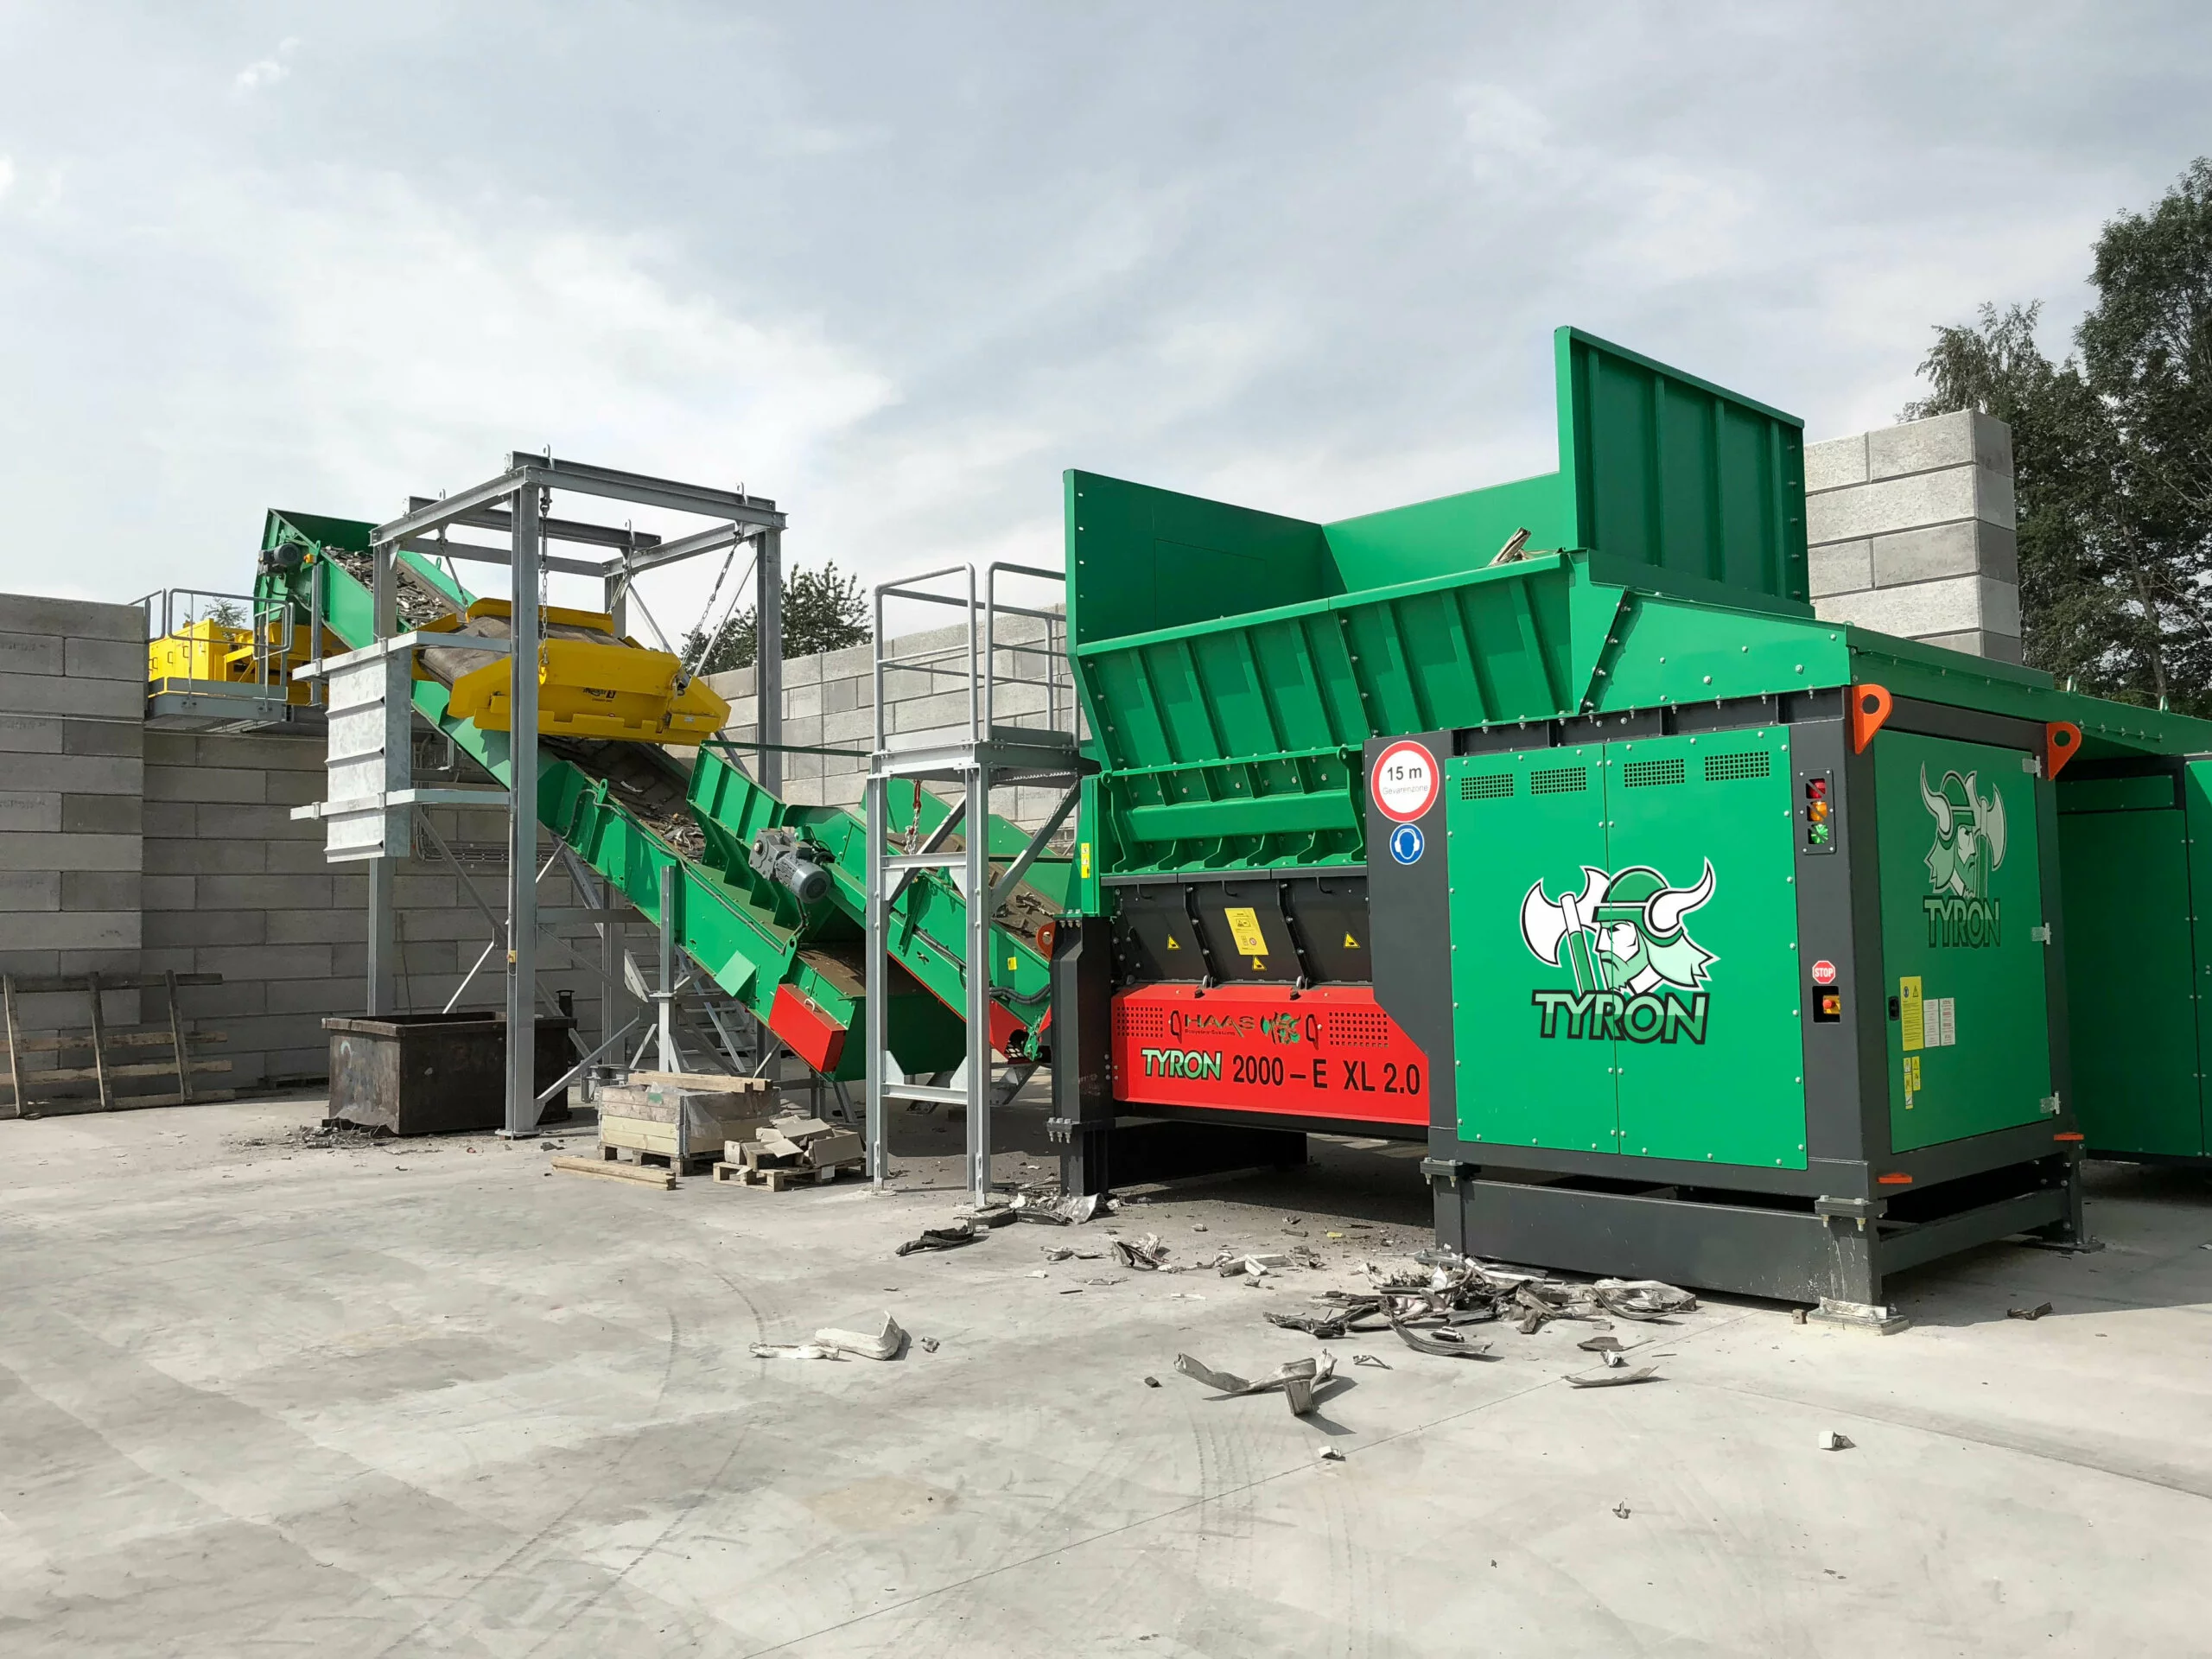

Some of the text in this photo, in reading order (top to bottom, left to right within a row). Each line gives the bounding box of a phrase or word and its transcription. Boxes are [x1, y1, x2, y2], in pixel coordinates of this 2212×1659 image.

[1387, 766, 1422, 781] 15 m
[1382, 785, 1428, 795] Gevarenzone
[1923, 895, 2000, 949] TYRON
[1815, 967, 1834, 977] STOP
[1185, 1014, 1255, 1037] HAAS
[1531, 989, 1710, 1045] TYRON
[1141, 1047, 1223, 1081] TYRON
[1232, 1054, 1284, 1086] 2000
[1313, 1058, 1328, 1089] E
[1343, 1059, 1376, 1092] XL
[1383, 1062, 1421, 1096] 2.0
